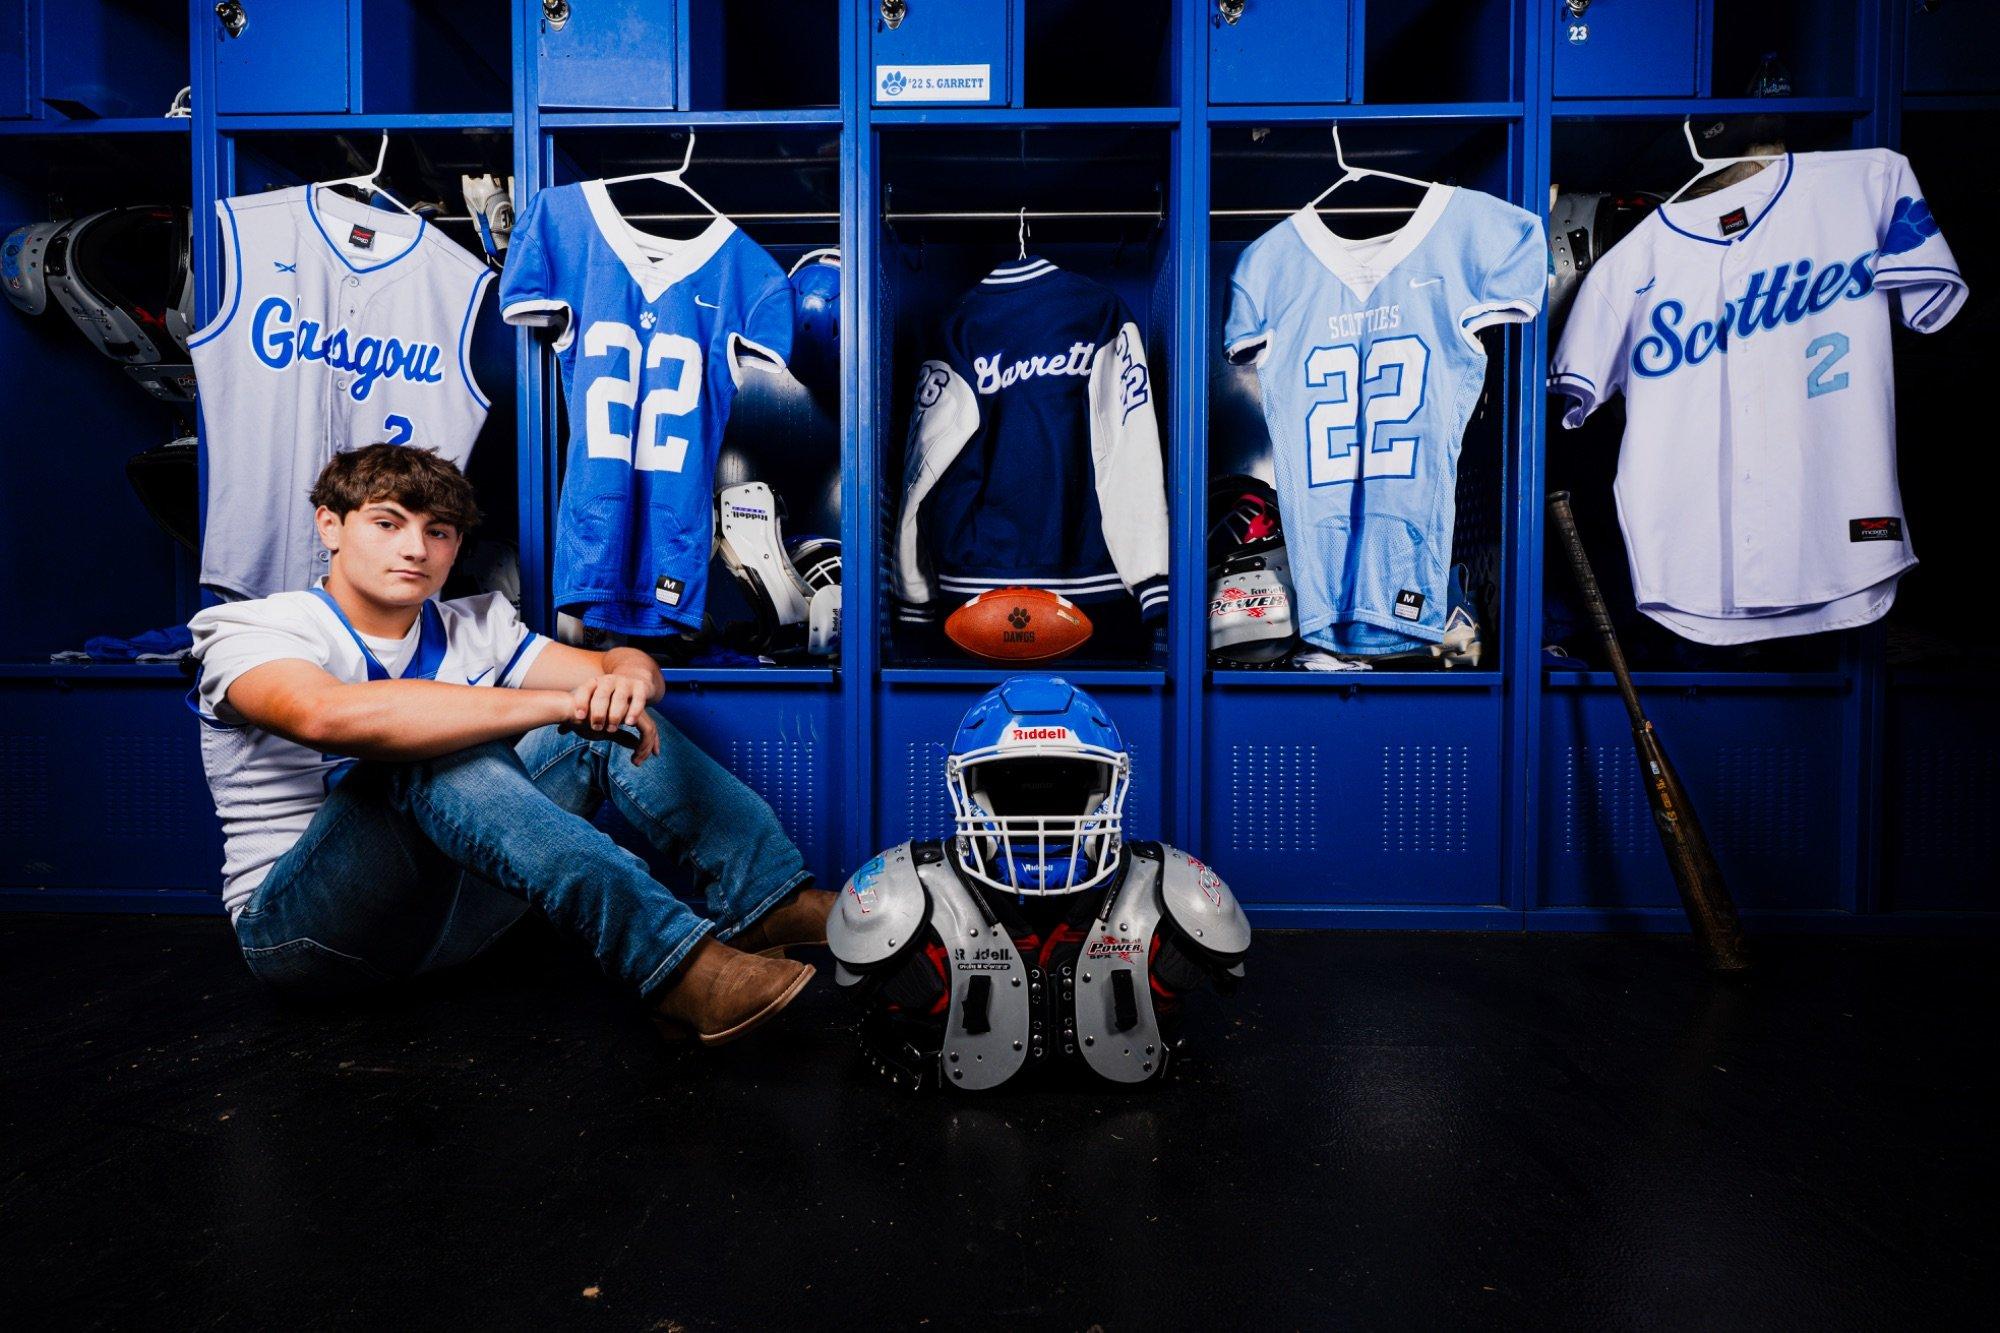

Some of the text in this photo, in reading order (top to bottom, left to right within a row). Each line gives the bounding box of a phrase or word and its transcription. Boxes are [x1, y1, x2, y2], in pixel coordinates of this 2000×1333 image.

[1569, 26, 1588, 41] 23
[926, 79, 934, 88] S.
[937, 78, 983, 88] GARRETT
[1328, 305, 1400, 340] SCOTTIES
[1630, 251, 1876, 380] Scotties
[251, 296, 443, 401] Gasgow
[1805, 331, 1850, 399] 2
[973, 341, 1095, 395] Garrett
[584, 321, 703, 473] 22
[1304, 334, 1431, 489] 22
[384, 413, 414, 446] 2
[663, 579, 676, 589] M
[1403, 593, 1415, 603] M
[1003, 631, 1035, 643] DAWGS
[1013, 728, 1066, 740] Riddell
[1022, 863, 1053, 873] Ridell
